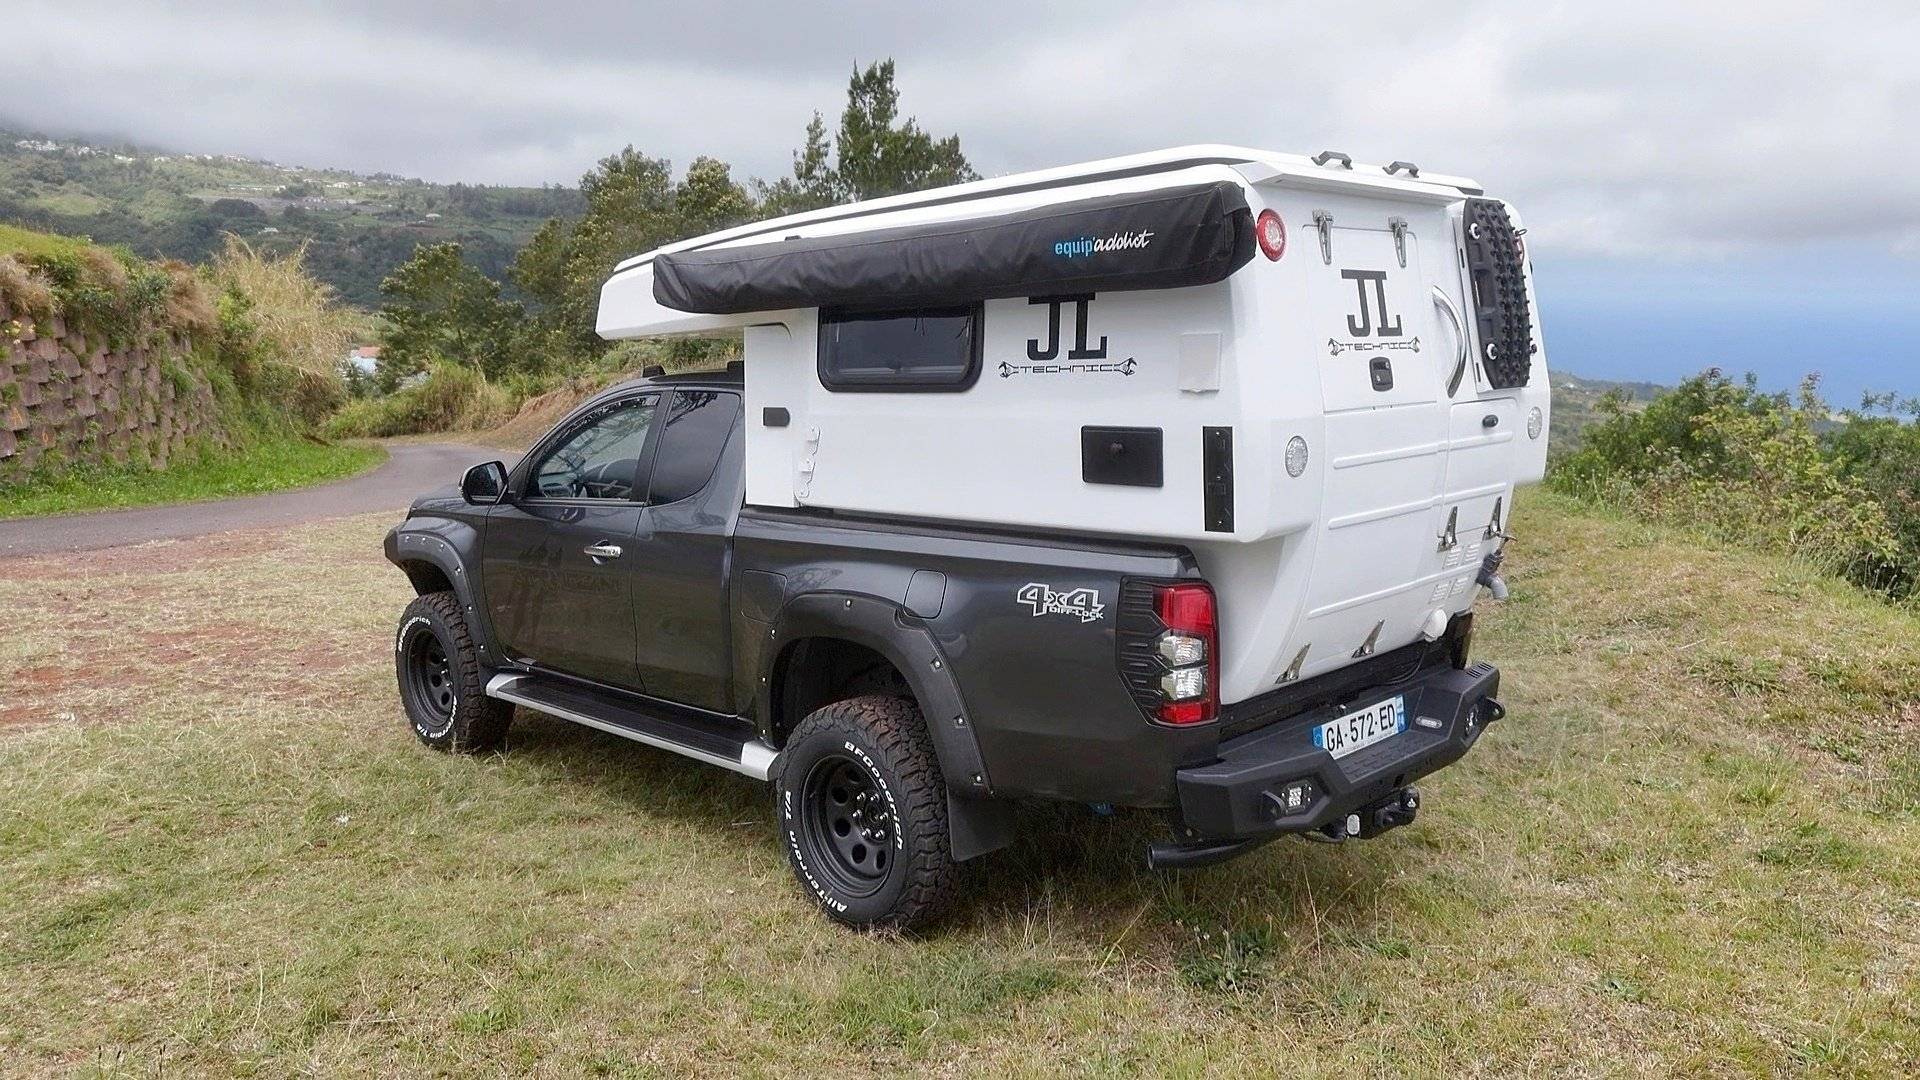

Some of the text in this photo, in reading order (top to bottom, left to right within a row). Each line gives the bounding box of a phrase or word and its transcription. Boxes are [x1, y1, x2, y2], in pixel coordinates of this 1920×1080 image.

[1027, 293, 1108, 361] JL
[1341, 269, 1403, 337] JL
[844, 741, 904, 850] BFGoodrich
